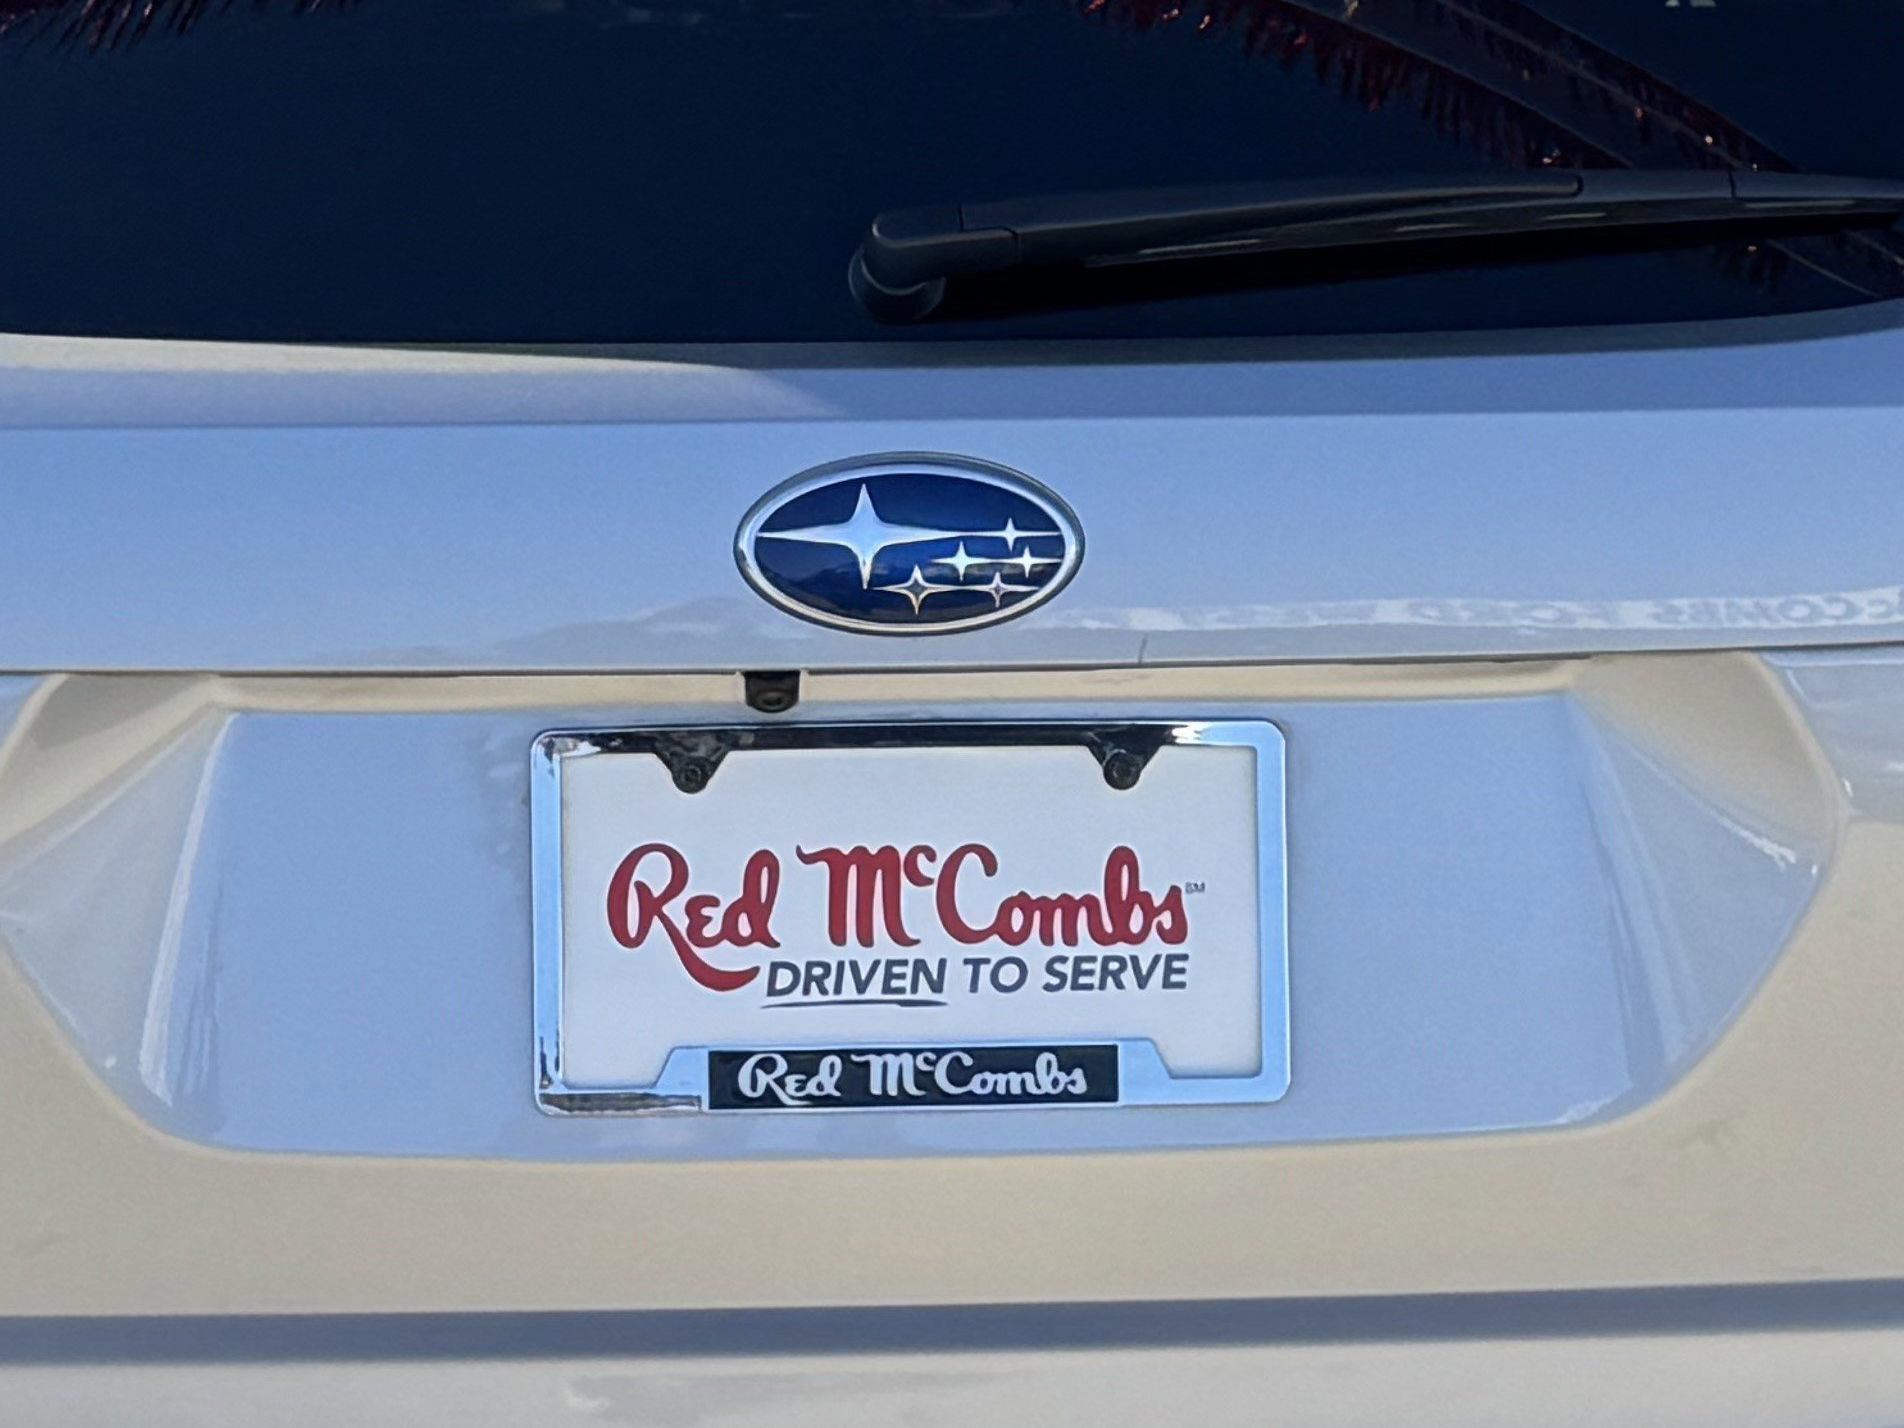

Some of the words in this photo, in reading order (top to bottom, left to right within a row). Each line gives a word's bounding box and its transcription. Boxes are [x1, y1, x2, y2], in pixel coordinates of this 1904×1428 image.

[607, 842, 781, 992] Red
[795, 842, 1189, 947] McCombs
[765, 956, 947, 997] DRIVEN
[967, 955, 1034, 994] TO
[1042, 952, 1190, 992] SERVE
[737, 1050, 843, 1106] Red
[849, 1049, 1089, 1098] McCombs
